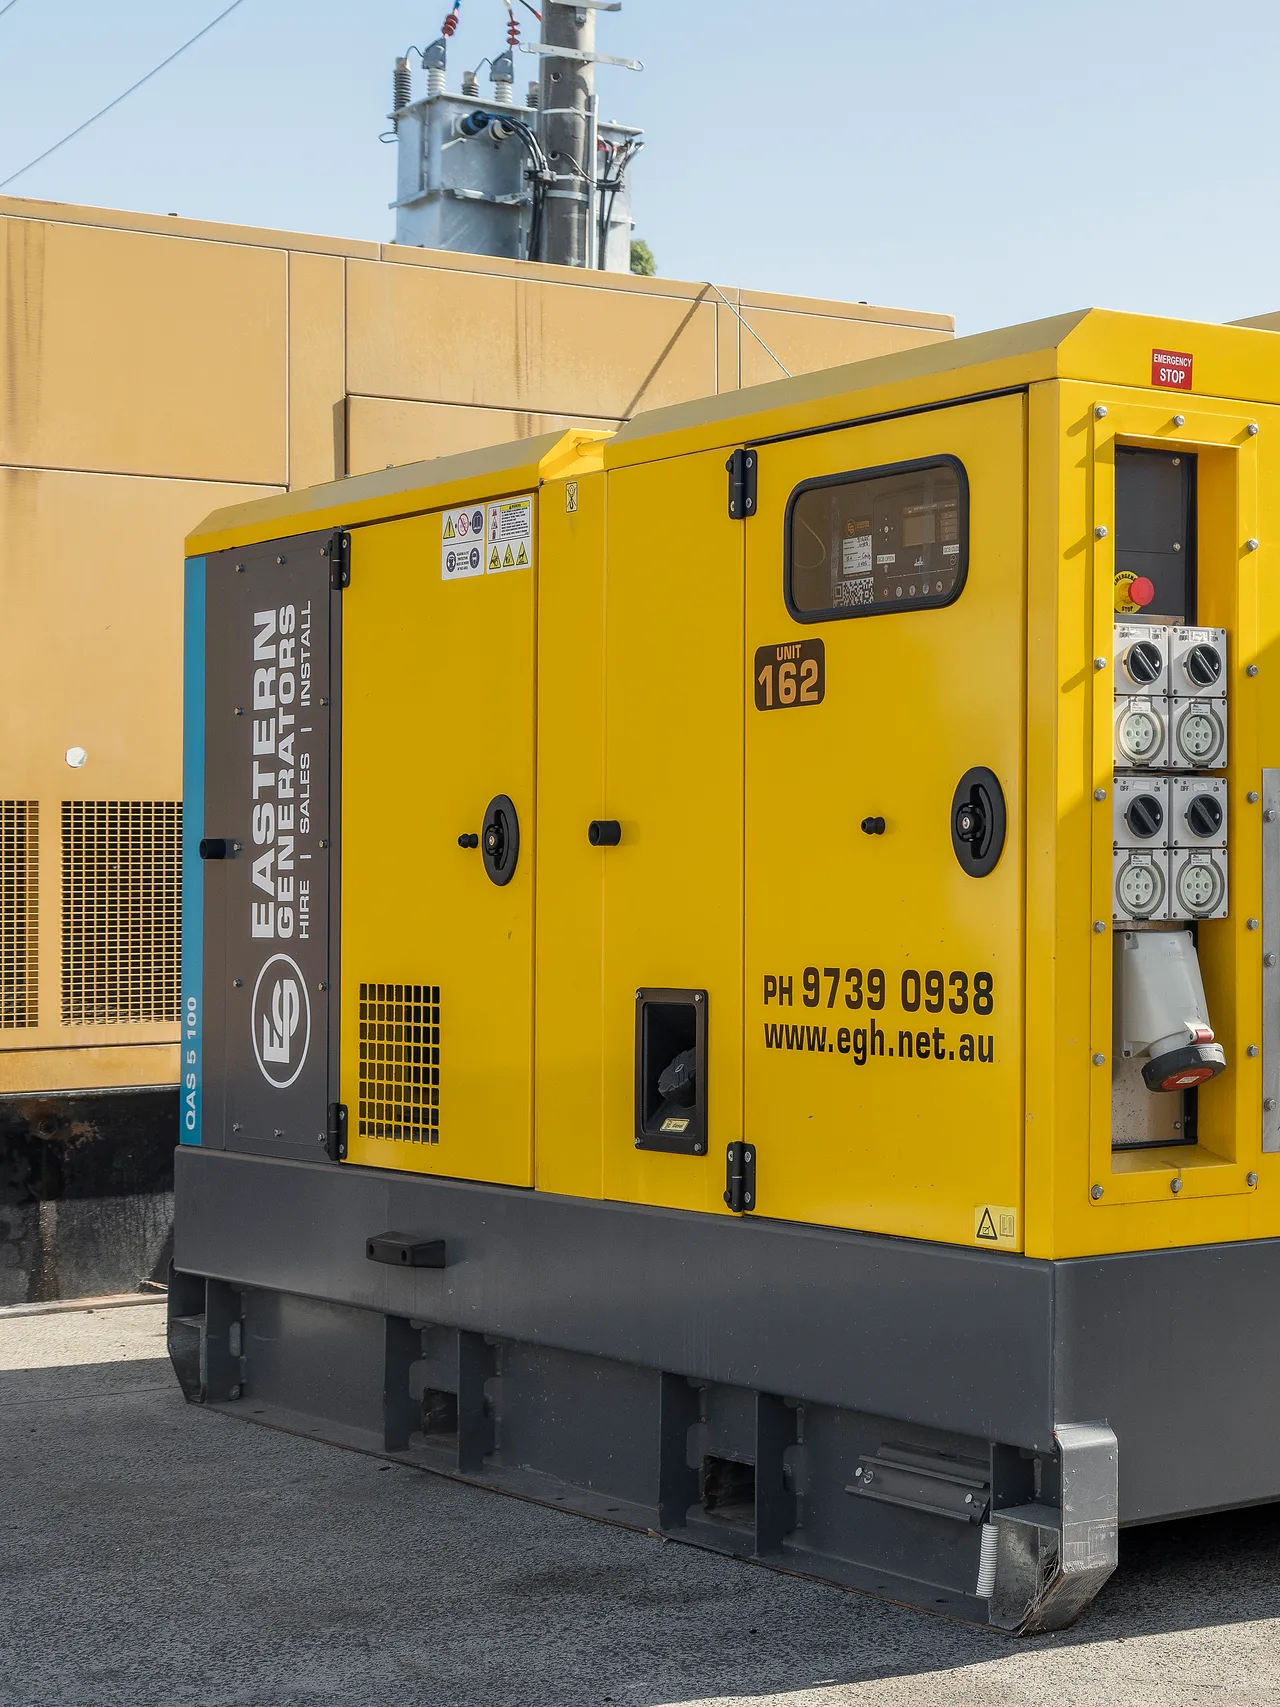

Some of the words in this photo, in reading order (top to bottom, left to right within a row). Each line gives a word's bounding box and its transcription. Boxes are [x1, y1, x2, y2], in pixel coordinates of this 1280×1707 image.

[1153, 353, 1192, 367] EMERGENCY
[1160, 367, 1185, 384] STOP
[300, 600, 311, 707] INSTALL
[776, 644, 802, 661] UNIT
[758, 659, 819, 707] 162
[252, 609, 277, 938] EASTERN
[277, 604, 296, 939] GENERATORS
[300, 752, 310, 834] SALES
[299, 880, 310, 939] HIRE
[764, 974, 793, 1006] PH
[803, 966, 886, 1011] 9739
[901, 969, 994, 1016] 0938
[187, 996, 197, 1040] 100
[764, 1018, 994, 1066] www.egh.net.au
[186, 1050, 197, 1065] 5
[186, 1073, 197, 1131] QAS
